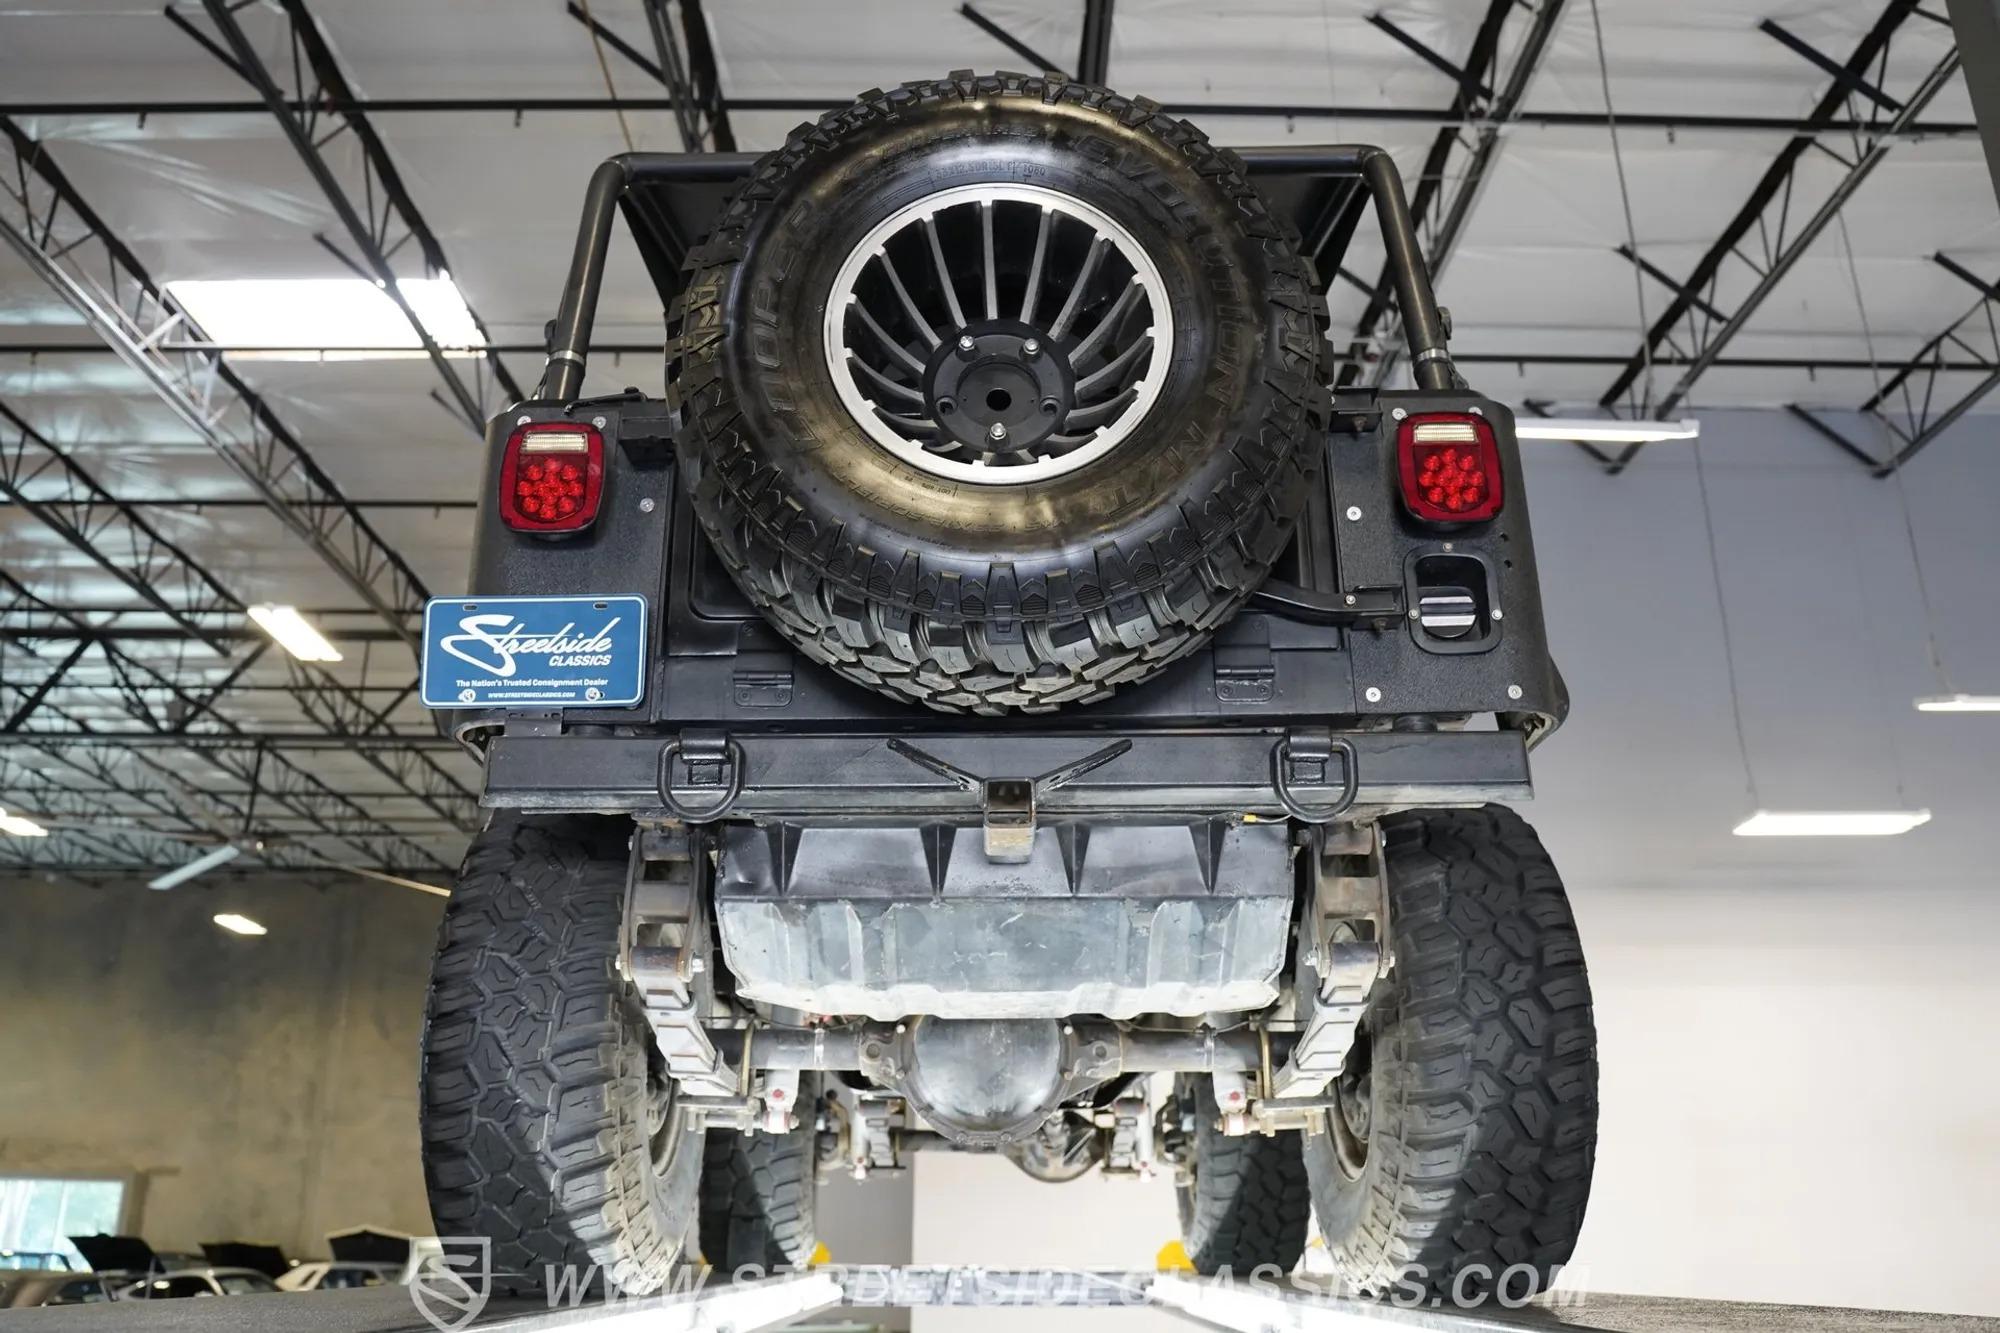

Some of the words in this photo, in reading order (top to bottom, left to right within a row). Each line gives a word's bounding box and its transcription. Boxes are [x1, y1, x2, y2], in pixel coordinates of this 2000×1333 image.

[753, 199, 824, 453] COOPER
[440, 614, 621, 677] Streetside
[549, 654, 612, 667] CLASSICS
[456, 679, 470, 687] The
[471, 679, 502, 687] Nation's
[503, 679, 531, 687] Trusted
[533, 678, 583, 688] Consignment
[584, 678, 609, 687] Dealer
